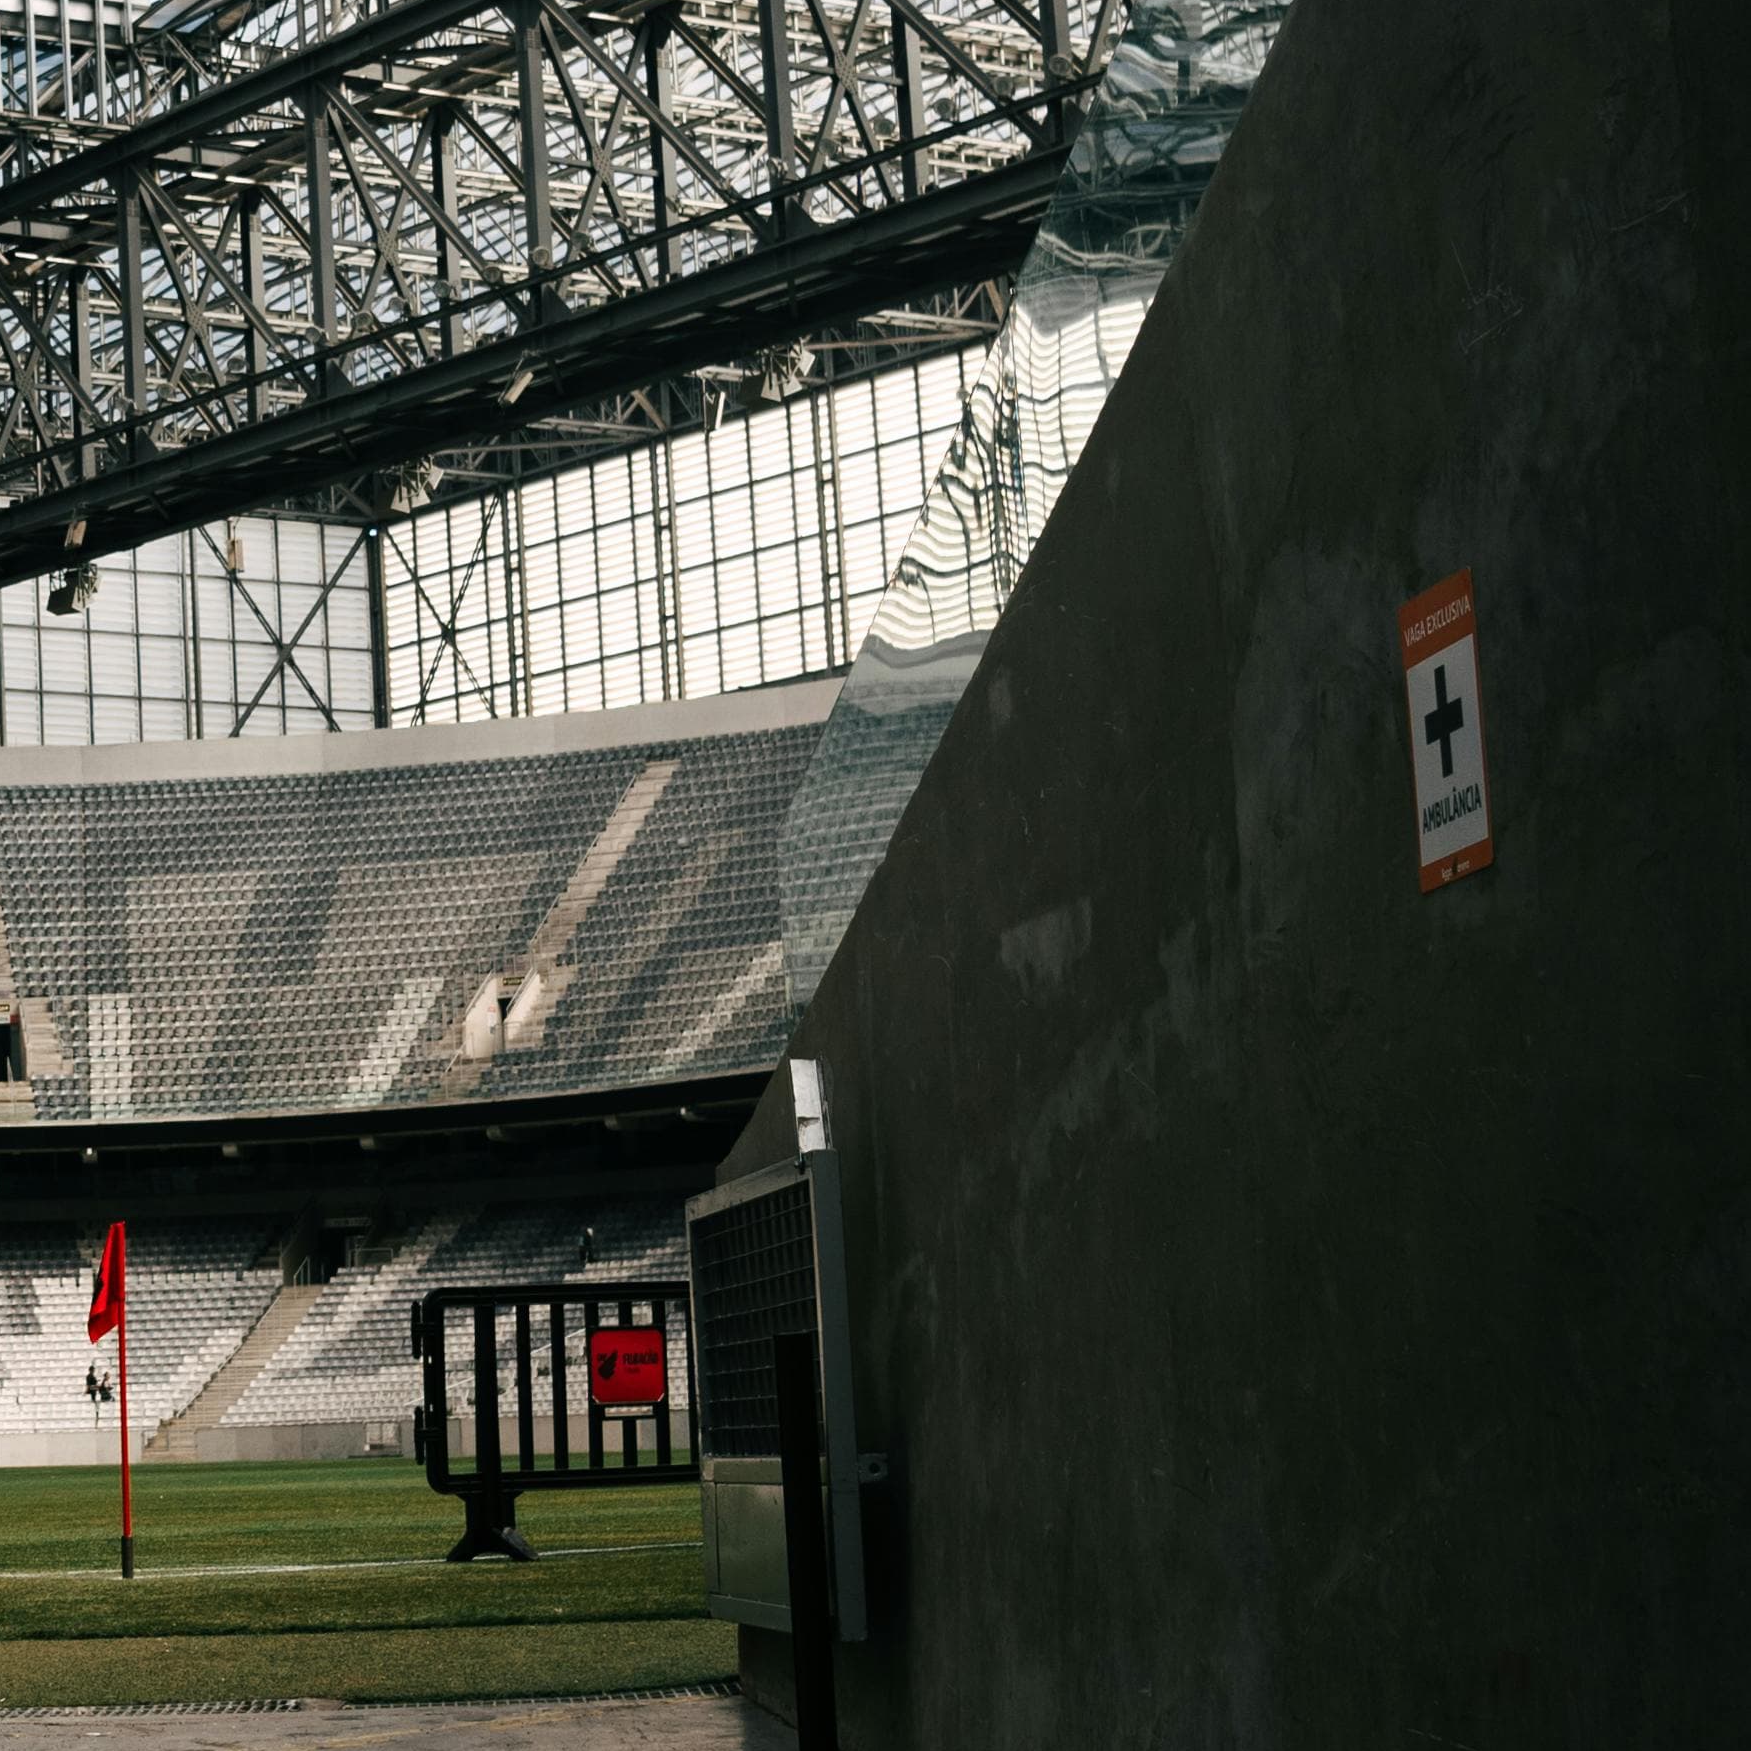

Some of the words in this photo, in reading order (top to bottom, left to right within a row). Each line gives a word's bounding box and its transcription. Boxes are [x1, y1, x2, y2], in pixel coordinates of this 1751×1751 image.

[1403, 620, 1427, 647] VAGA
[1426, 594, 1471, 635] EXCLUSIVA
[1422, 783, 1482, 834] AMBULÂNCIA
